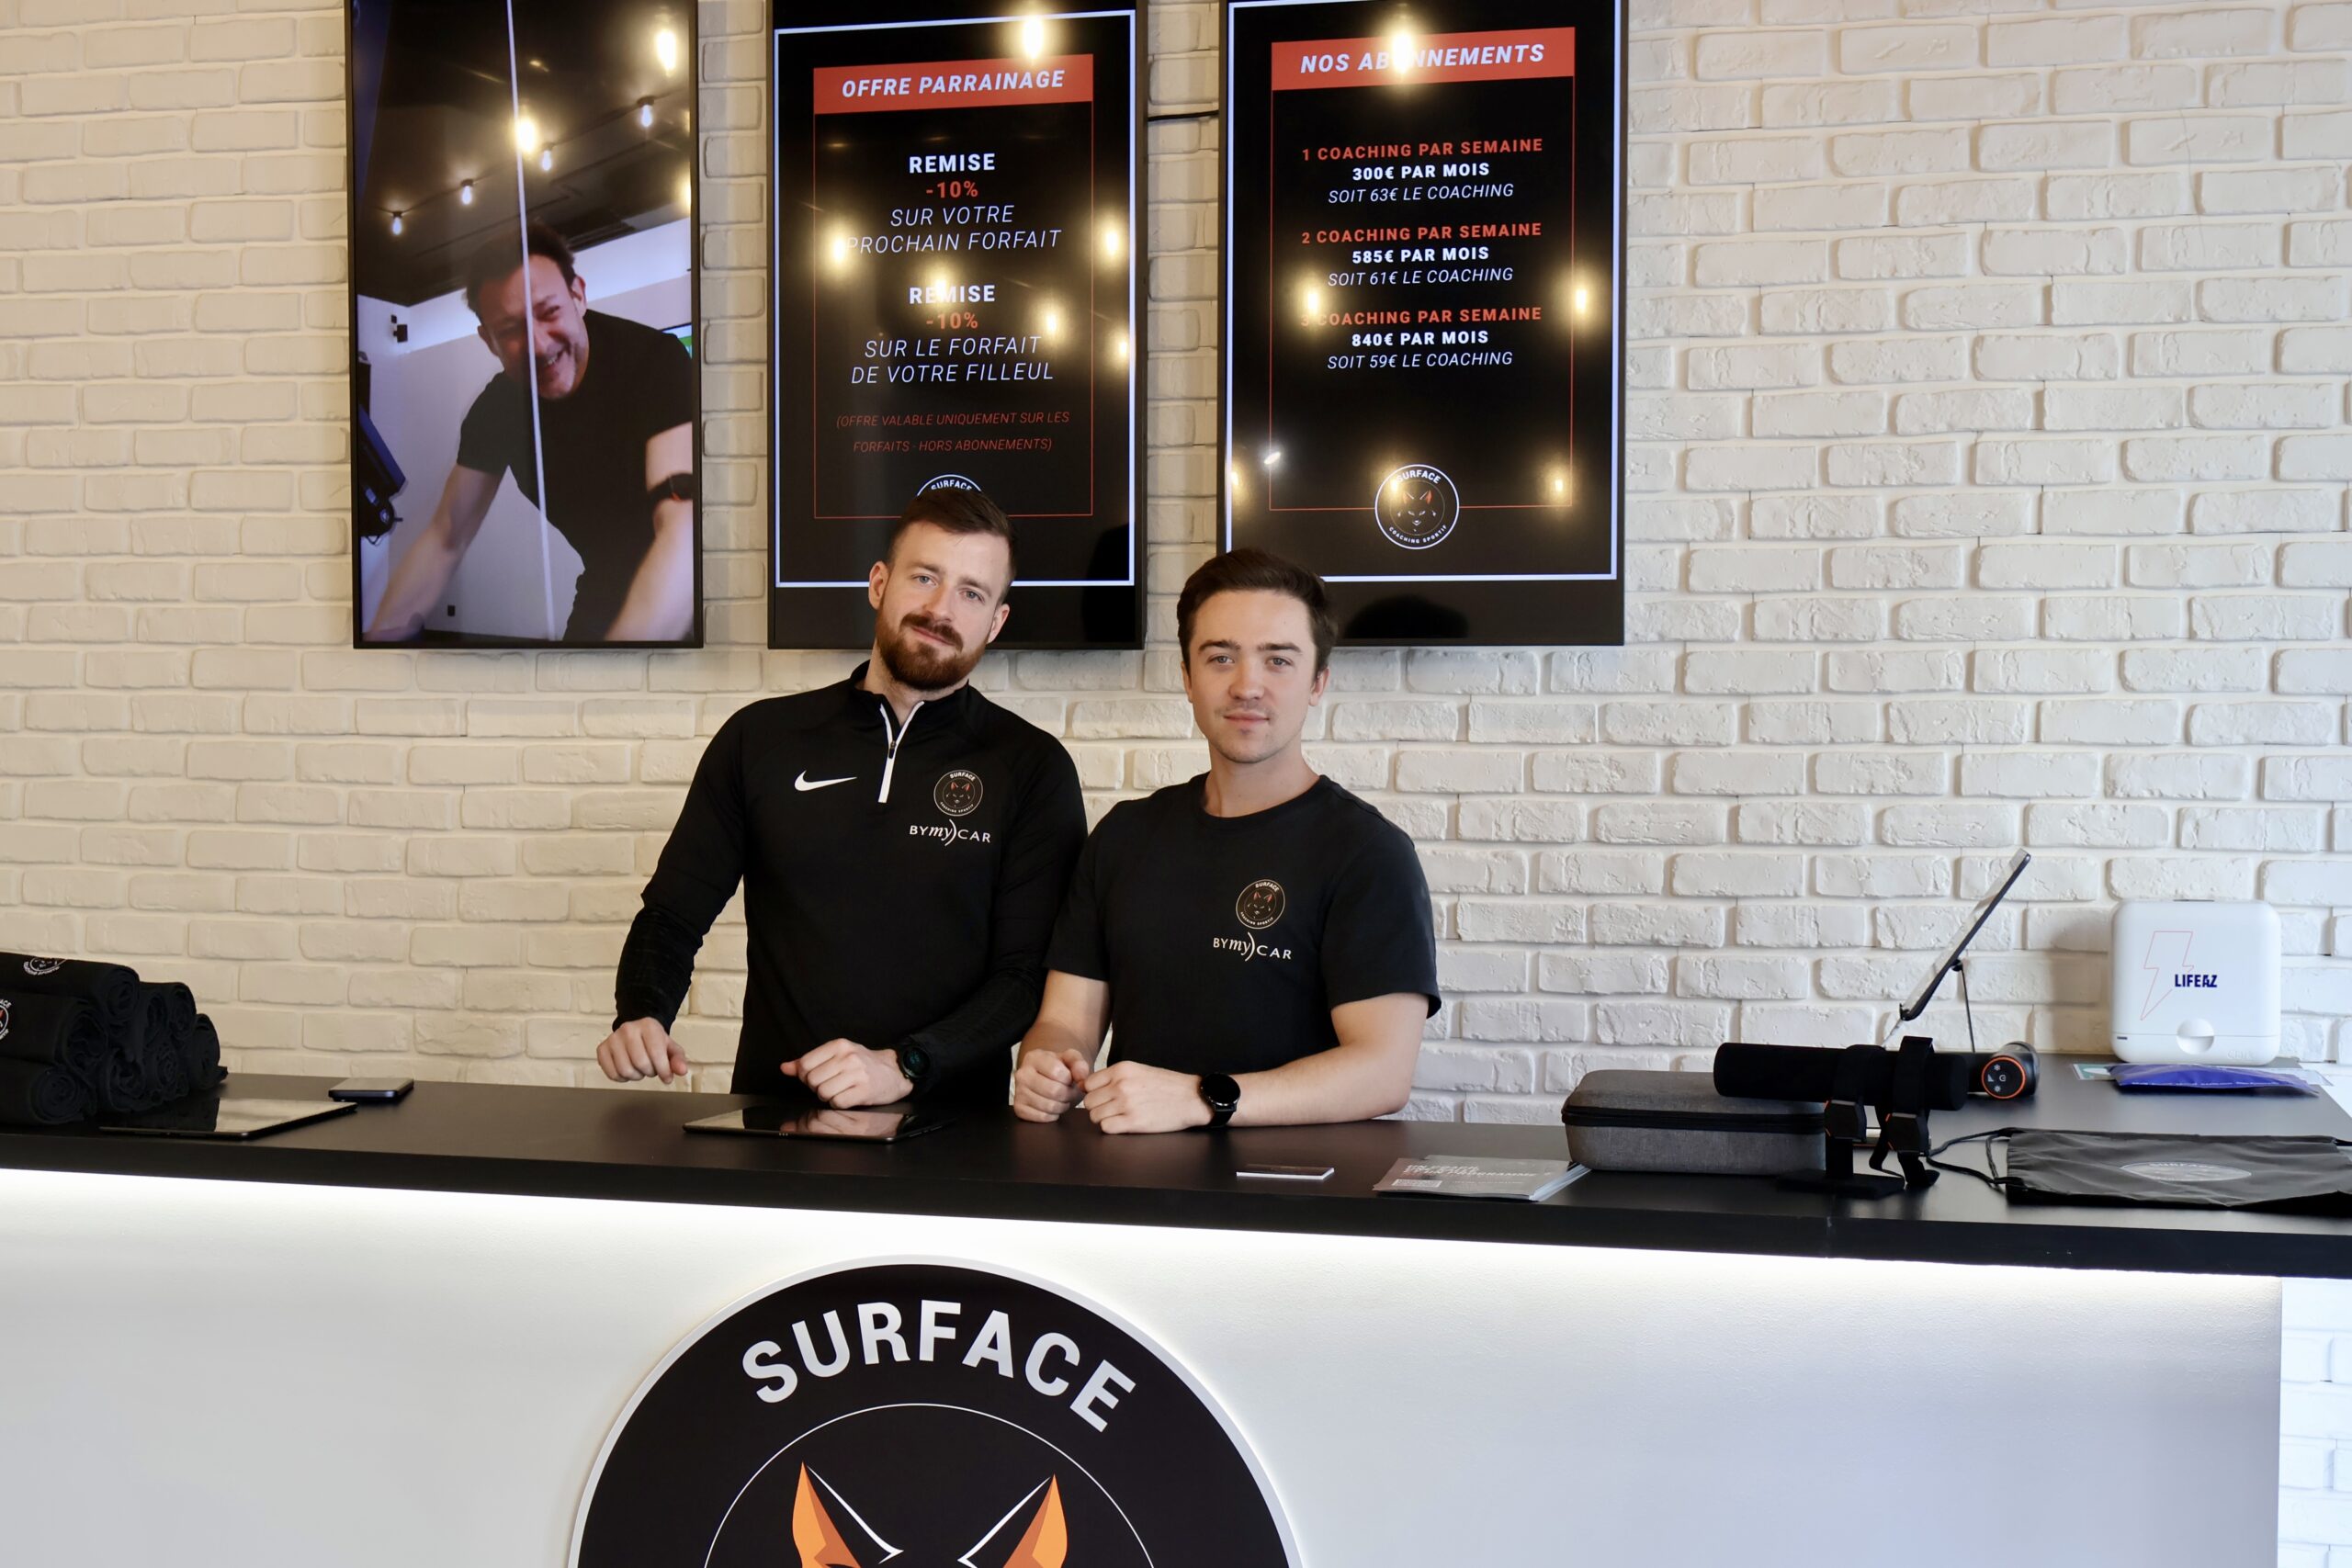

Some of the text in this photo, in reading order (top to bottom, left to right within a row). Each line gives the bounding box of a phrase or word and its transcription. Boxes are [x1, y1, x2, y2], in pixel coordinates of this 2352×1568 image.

[1301, 44, 1545, 73] NOS ABNNEMENTS
[842, 70, 1065, 97] OFFRE PARRAINAGE
[1303, 139, 1542, 161] 1 COACHING PAR SEMAINE
[910, 153, 995, 173] REMISE
[1352, 163, 1488, 180] 300€ PAR MOIS
[926, 181, 978, 198] -10%
[1329, 184, 1513, 203] SOIT 63€ LE COACHING
[890, 205, 1014, 226] SUR VOTRE
[846, 230, 1061, 254] PROCHAIN FORFAIT
[1302, 223, 1541, 243] 2 COACHING PAR SEMAINE
[1352, 246, 1488, 264] 585€ PAR MOIS
[1328, 267, 1513, 288] SOIT 61€ LE COACHING
[909, 286, 995, 304] REMISE
[925, 311, 979, 330] -10%
[1301, 307, 1543, 327] 3 COACHING PAR SEMAINE
[865, 336, 1042, 357] SUR LE FORFAIT
[1352, 331, 1487, 346] 840€ PAR MOIS
[1328, 352, 1512, 368] SOIT 59€ LE COACHING
[852, 362, 1055, 383] DE VOTRE FILLEUL
[837, 412, 1069, 429] (OFFRE VALABLE UNIQUEMENT SUR LES
[853, 440, 910, 453] FORFAITS
[919, 440, 953, 451] HORS
[955, 438, 1052, 451] ABONNEMENTS)
[1396, 469, 1442, 484] SURFACE
[949, 772, 976, 782] SURFACE
[1255, 882, 1280, 892] SURFACE
[2174, 974, 2218, 987] LIFEAZ
[741, 1299, 1136, 1433] SURFACE
